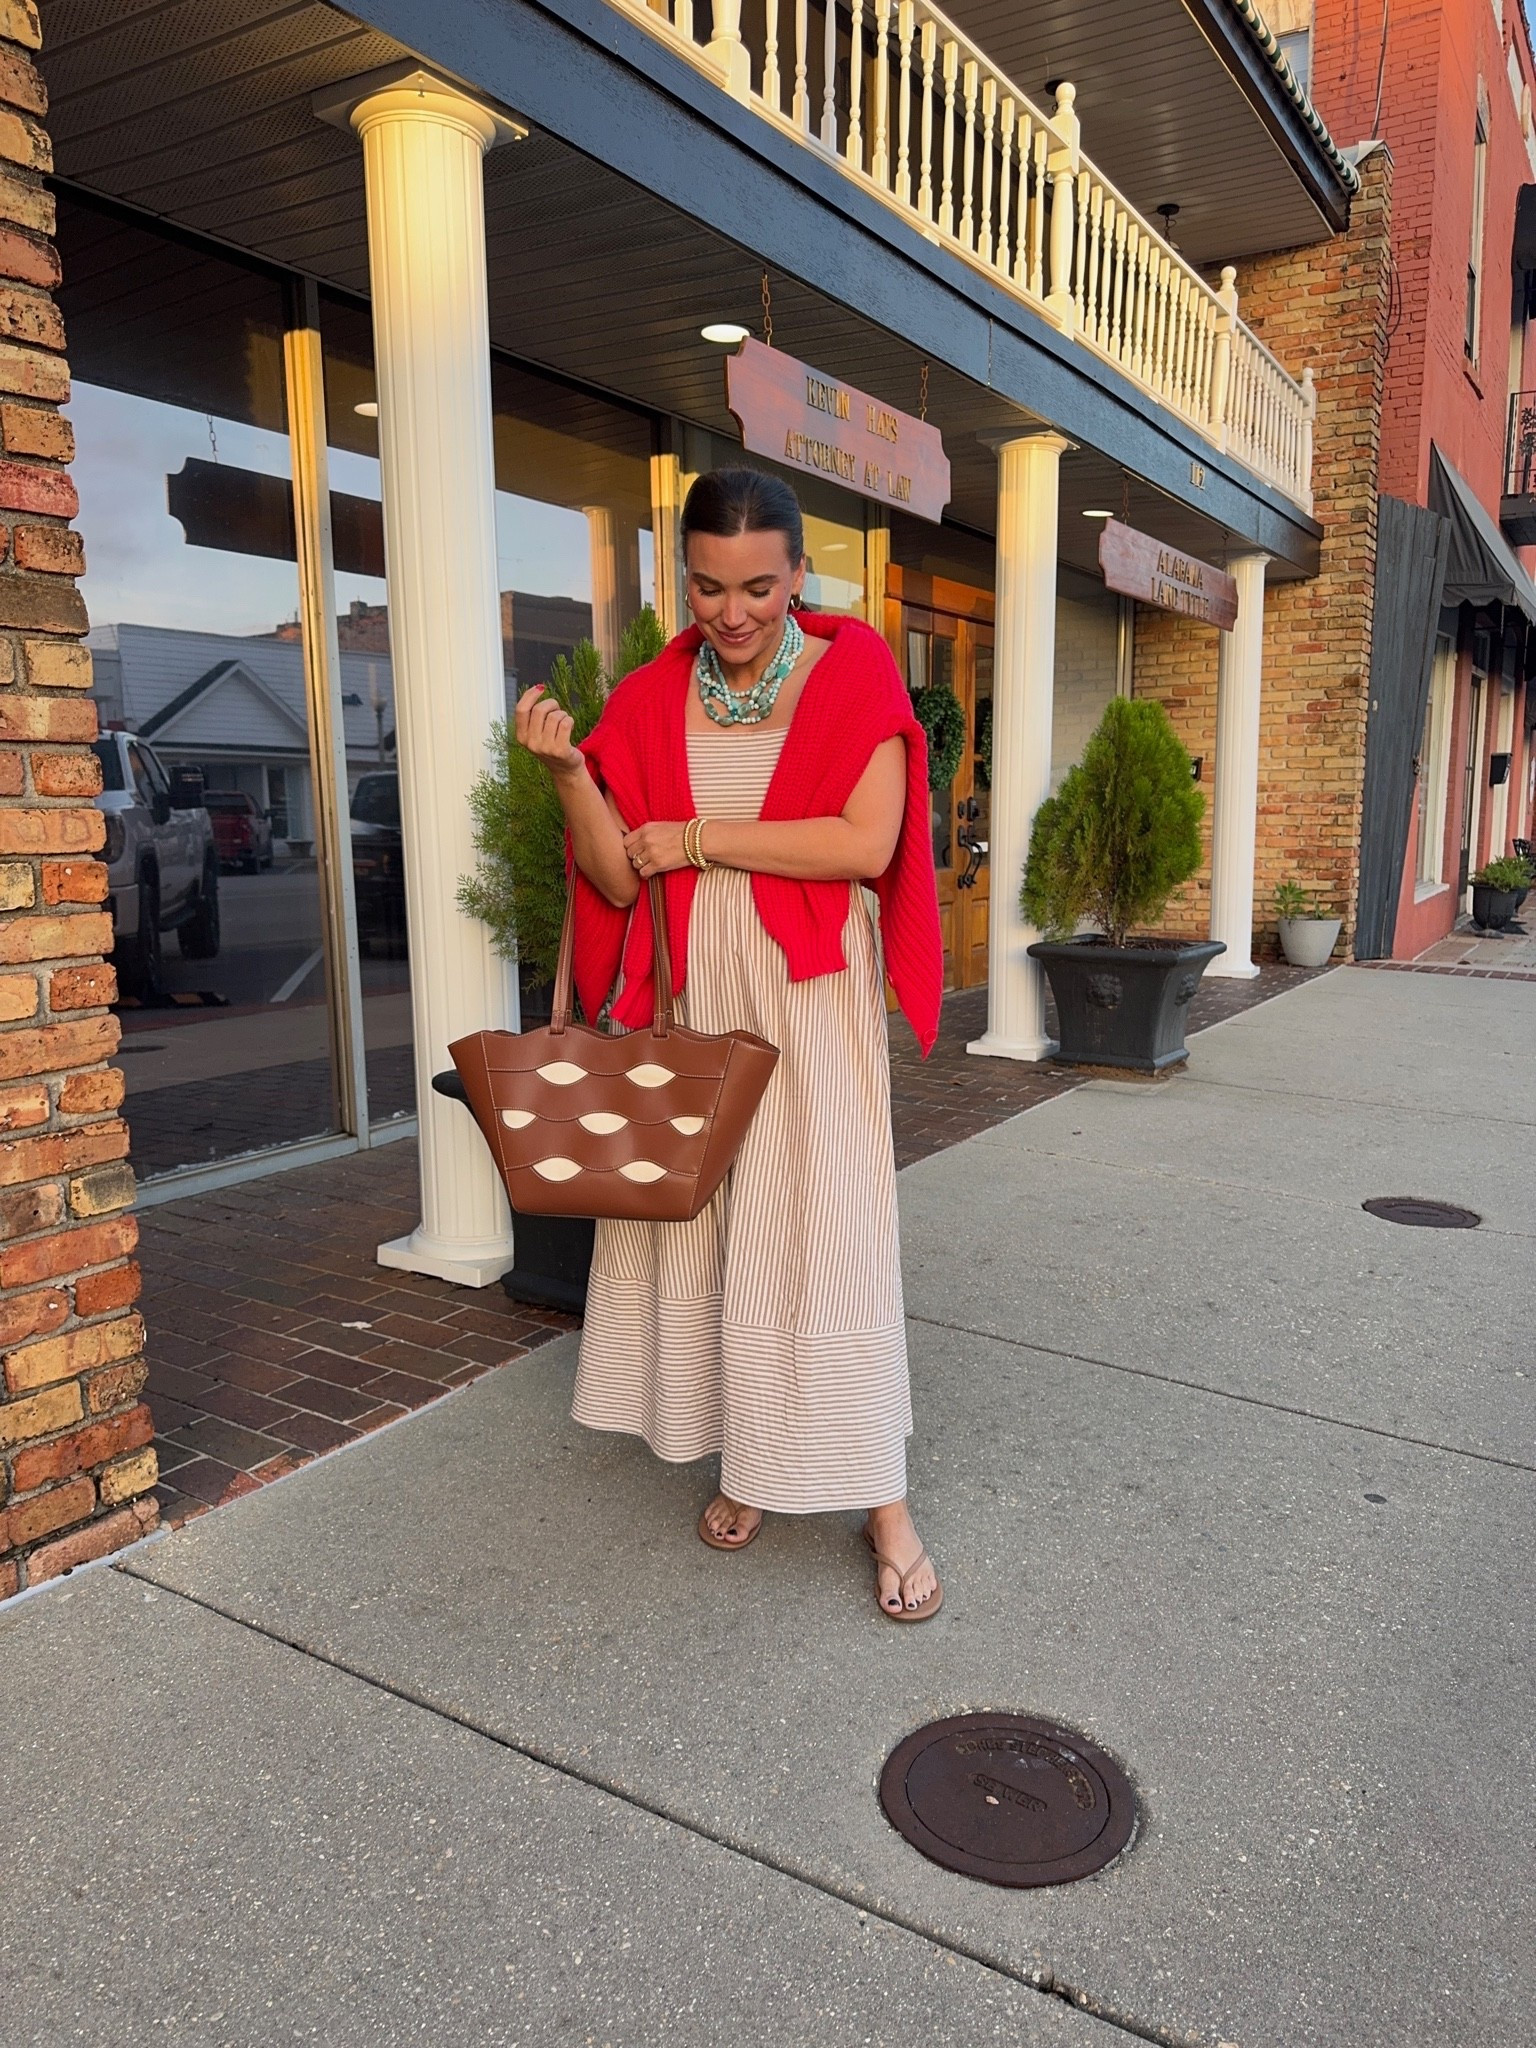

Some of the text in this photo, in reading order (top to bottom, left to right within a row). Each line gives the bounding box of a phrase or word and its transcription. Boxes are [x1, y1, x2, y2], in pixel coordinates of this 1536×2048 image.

[806, 375, 898, 443] KEVIN HAYS
[784, 429, 912, 503] ATTORNEY AT LAW
[1157, 549, 1203, 591] ALABAMA
[1152, 577, 1209, 620] LAND TITLE
[973, 1774, 1042, 1812] SEWER
